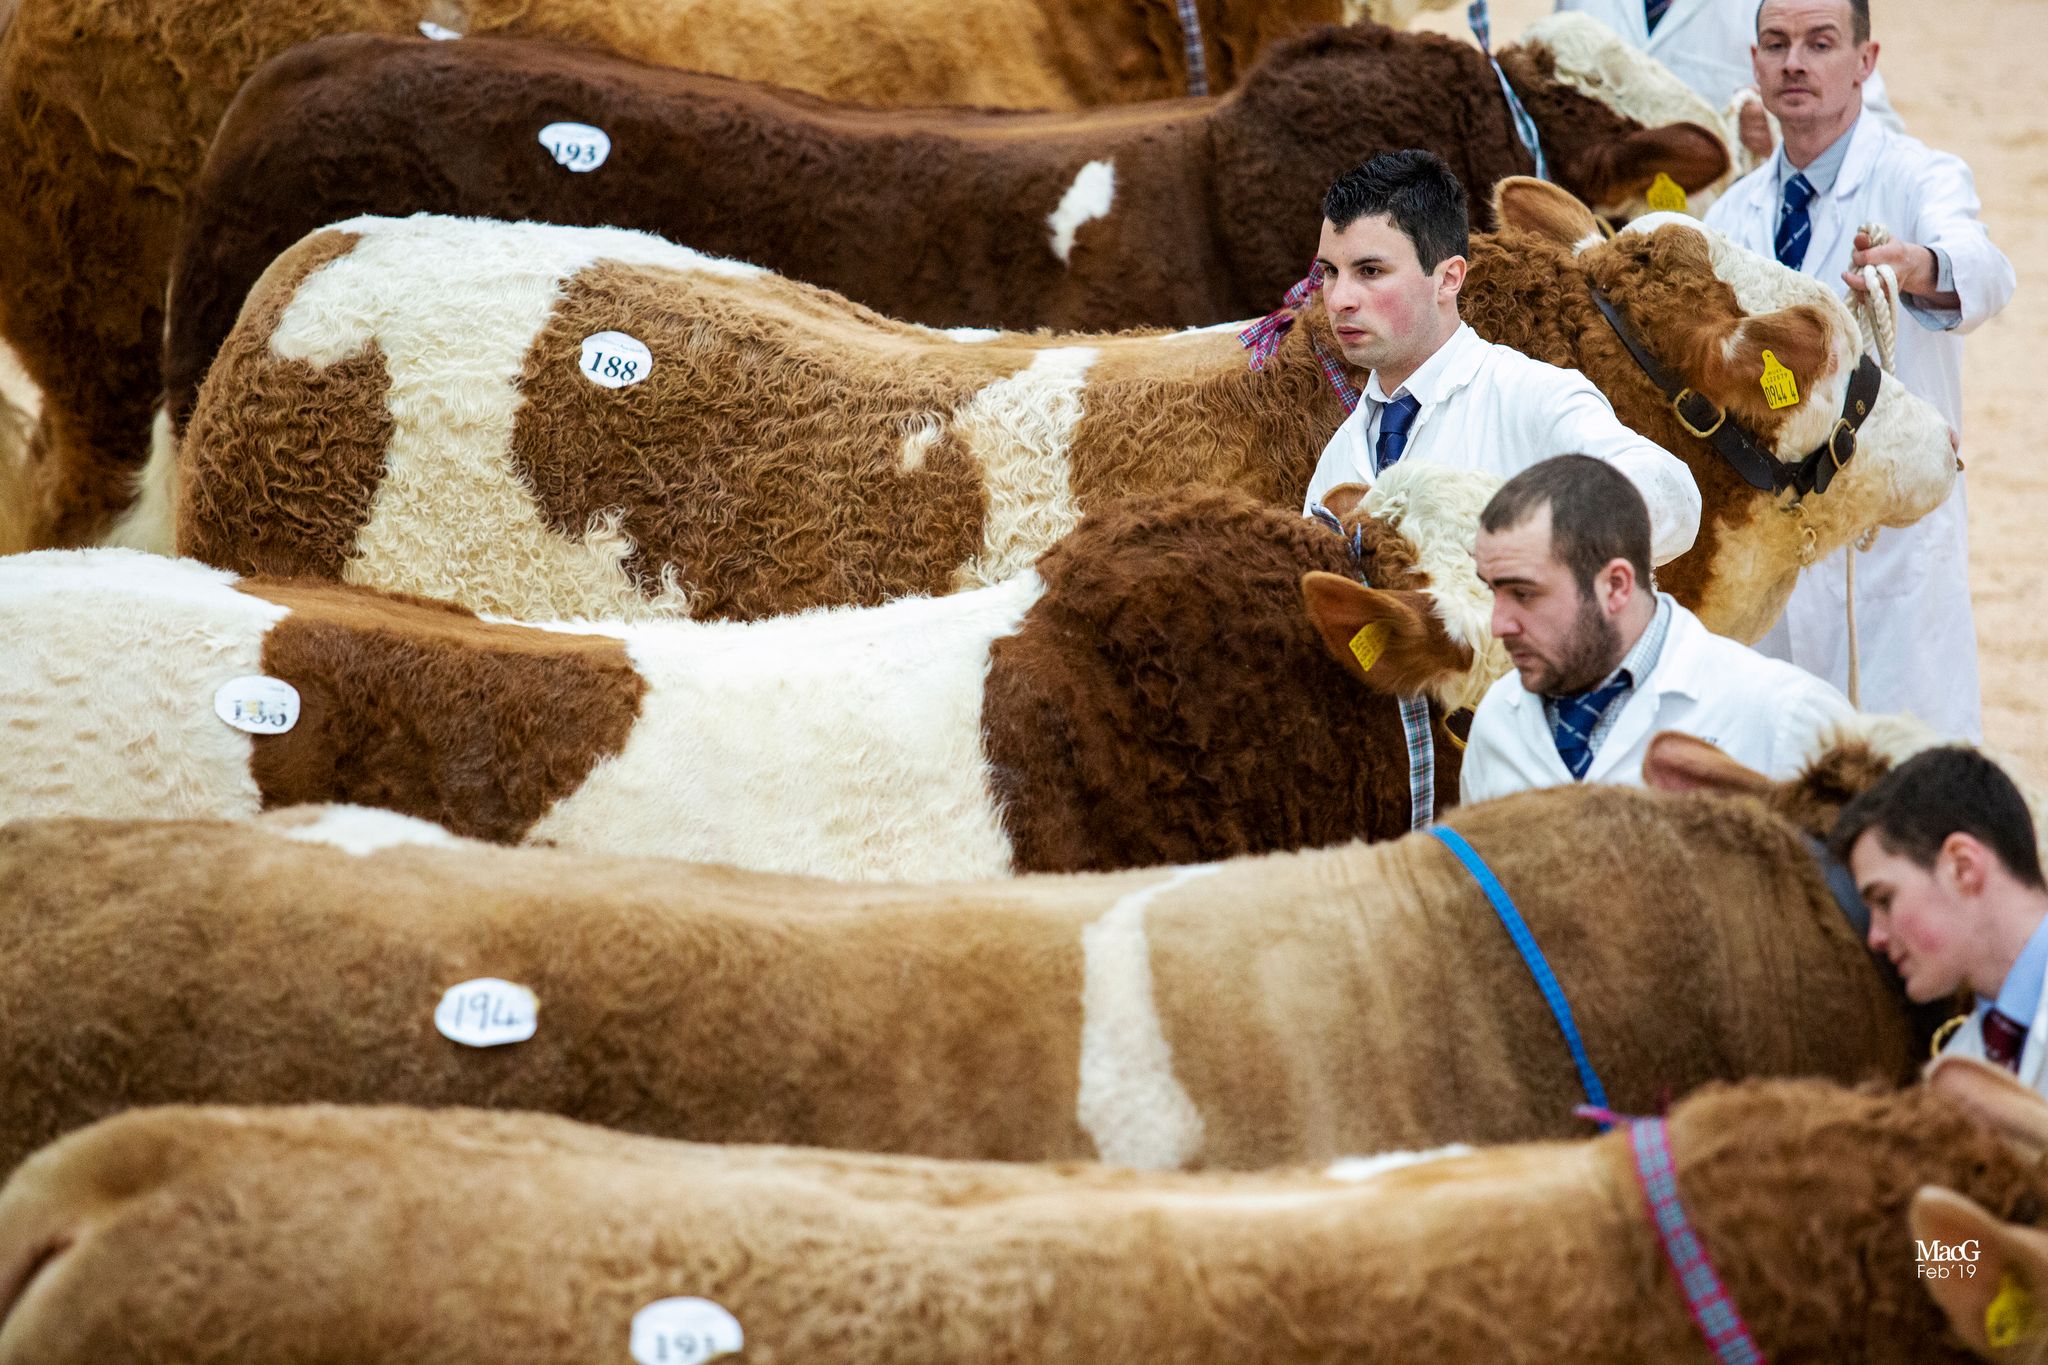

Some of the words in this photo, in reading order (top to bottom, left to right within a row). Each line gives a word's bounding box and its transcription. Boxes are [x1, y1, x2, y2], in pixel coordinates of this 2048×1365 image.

[554, 142, 596, 165] 193
[588, 351, 638, 382] 188
[454, 991, 522, 1030] 194
